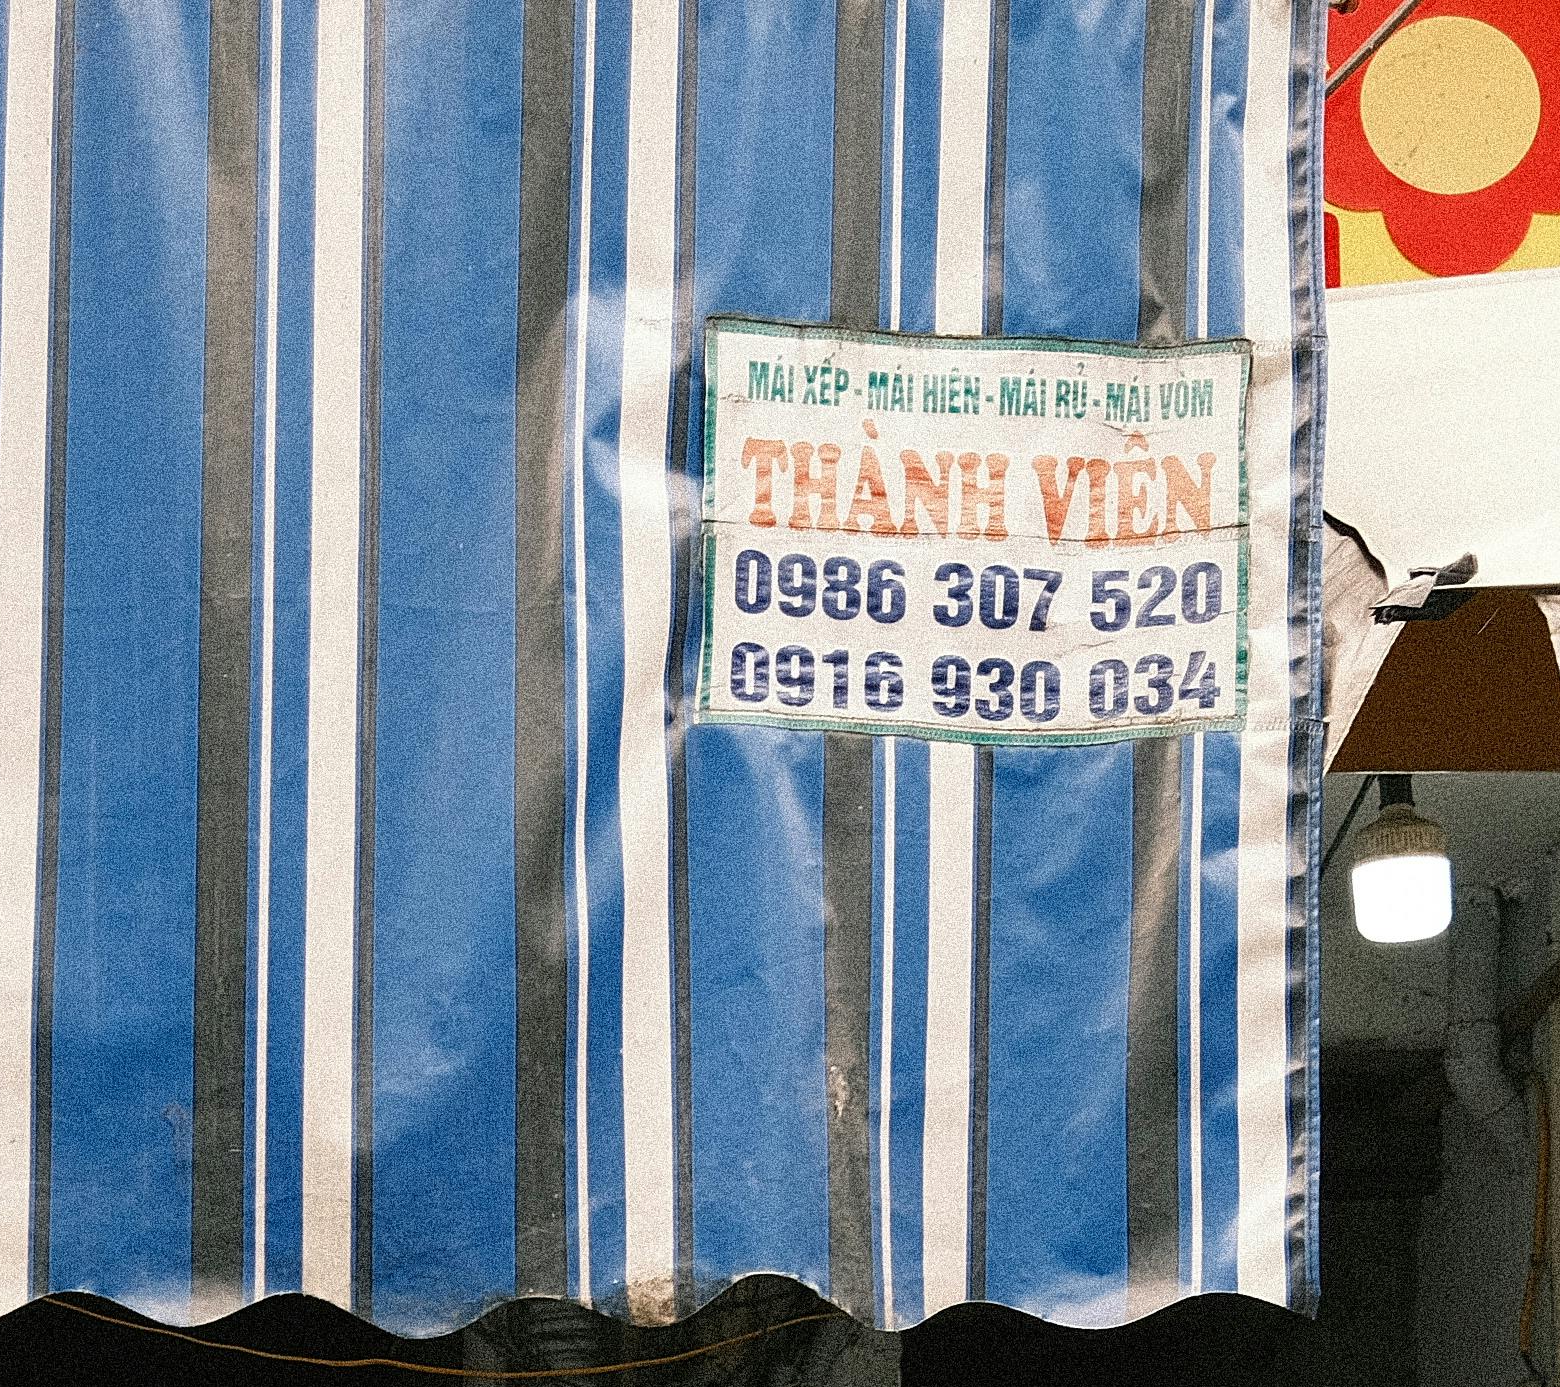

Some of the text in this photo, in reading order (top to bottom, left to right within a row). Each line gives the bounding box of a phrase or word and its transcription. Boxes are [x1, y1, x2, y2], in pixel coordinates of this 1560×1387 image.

[748, 355, 794, 403] MÁI
[802, 352, 850, 407] XẾP
[867, 364, 913, 414] MÁI
[922, 367, 980, 415] HIÊN
[998, 368, 1046, 417] MÁI
[1105, 375, 1150, 423] MÁI
[1160, 372, 1214, 420] VÒM
[741, 419, 1218, 549] THÀNH VIÊN
[735, 550, 1221, 632] 0986 307 520
[731, 642, 1220, 721] 0916 930 034
